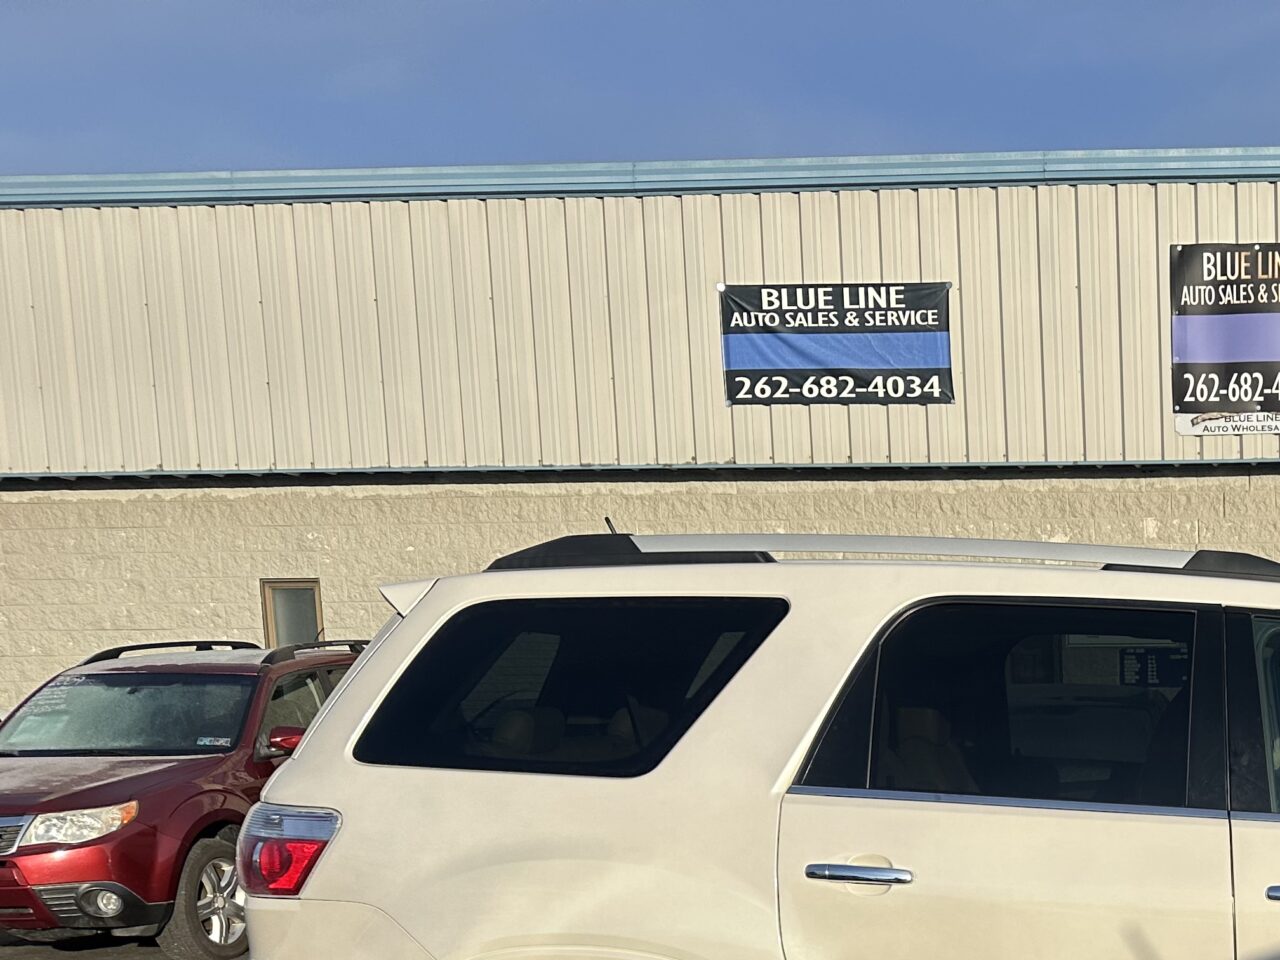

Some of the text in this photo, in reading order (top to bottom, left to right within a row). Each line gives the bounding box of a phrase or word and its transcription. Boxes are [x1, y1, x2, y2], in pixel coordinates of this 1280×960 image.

[1203, 252, 1251, 281] BLUE
[761, 286, 906, 310] BLUE LINE
[1181, 285, 1216, 306] AUTO
[1219, 283, 1254, 305] SALES
[1258, 283, 1268, 304] &
[730, 309, 939, 327] AUTO SALES & SERVICE
[734, 375, 942, 399] 262-682-4034
[1202, 424, 1229, 433] AUTO
[1224, 414, 1253, 422] BLUE
